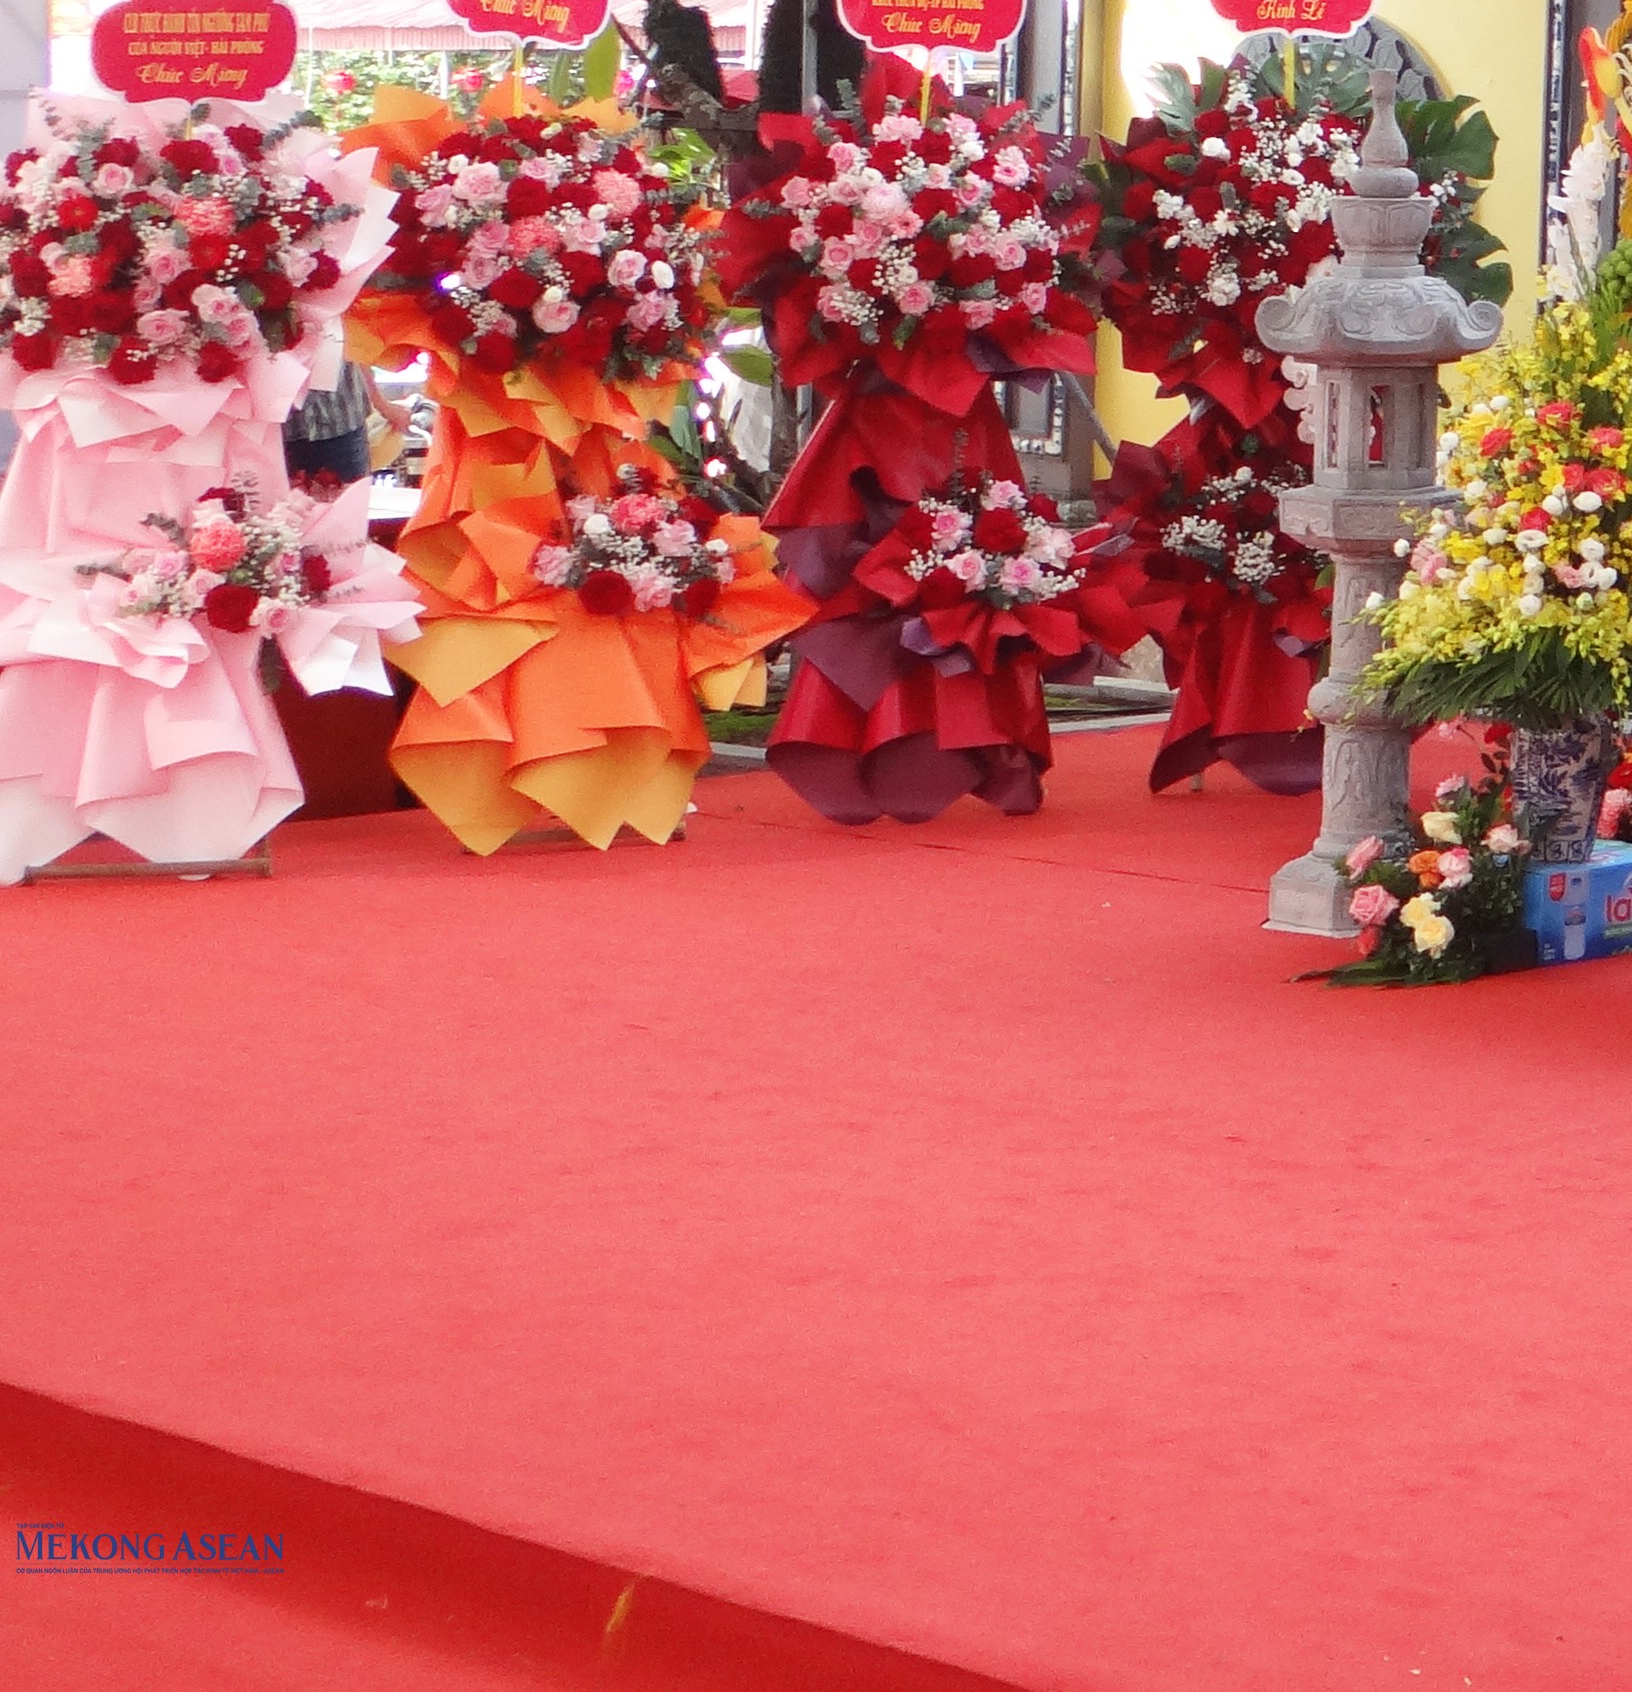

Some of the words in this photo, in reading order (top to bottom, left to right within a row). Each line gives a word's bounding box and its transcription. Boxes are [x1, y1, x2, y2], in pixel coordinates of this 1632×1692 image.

[882, 12, 923, 33] Chúc
[929, 13, 981, 43] Mừng
[137, 62, 184, 83] Chúc
